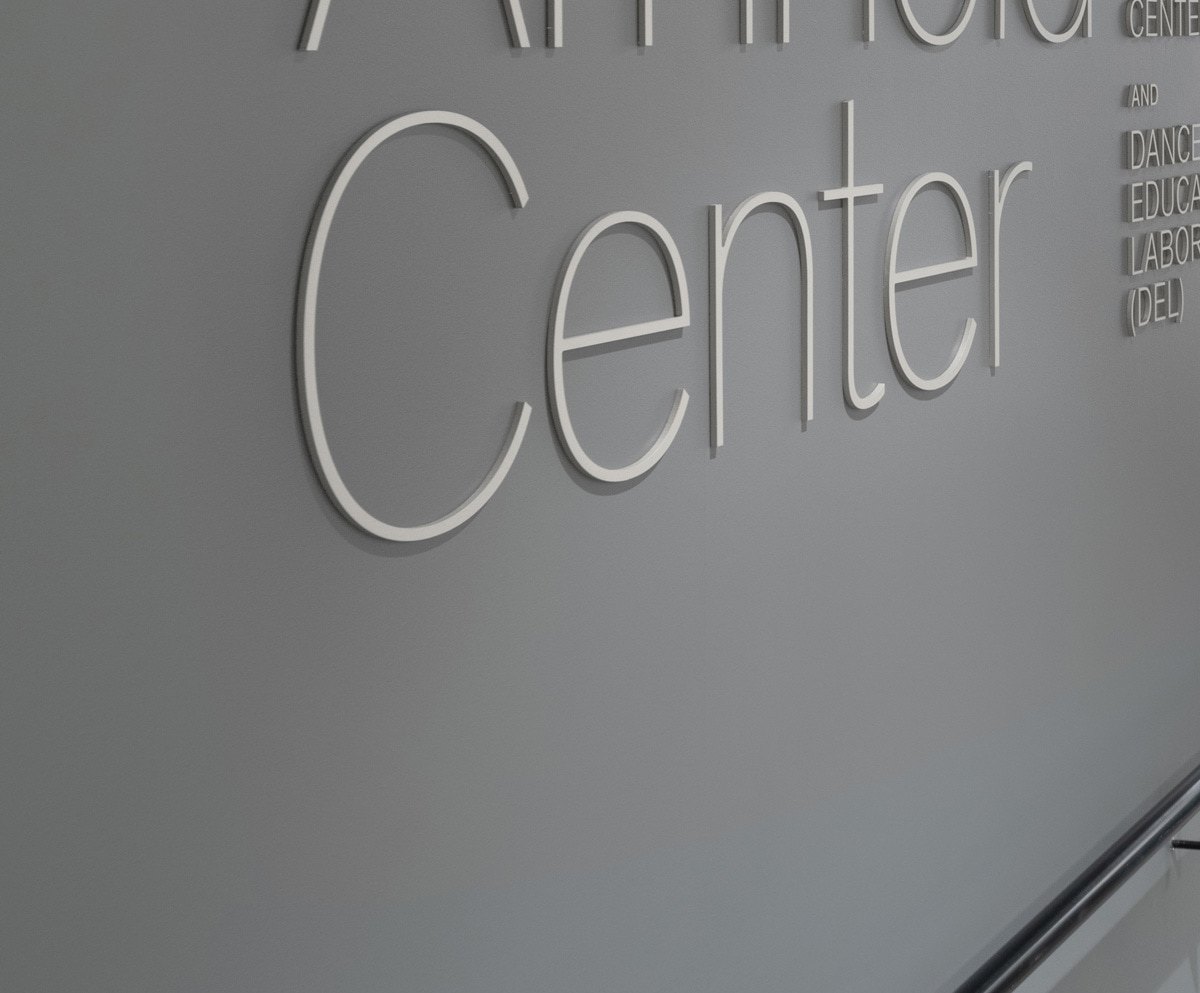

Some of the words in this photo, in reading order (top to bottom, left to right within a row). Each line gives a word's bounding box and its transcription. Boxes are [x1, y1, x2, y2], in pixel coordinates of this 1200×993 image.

[1130, 83, 1159, 108] AND
[296, 100, 1032, 542] Center
[1127, 278, 1184, 336] (DEL)
